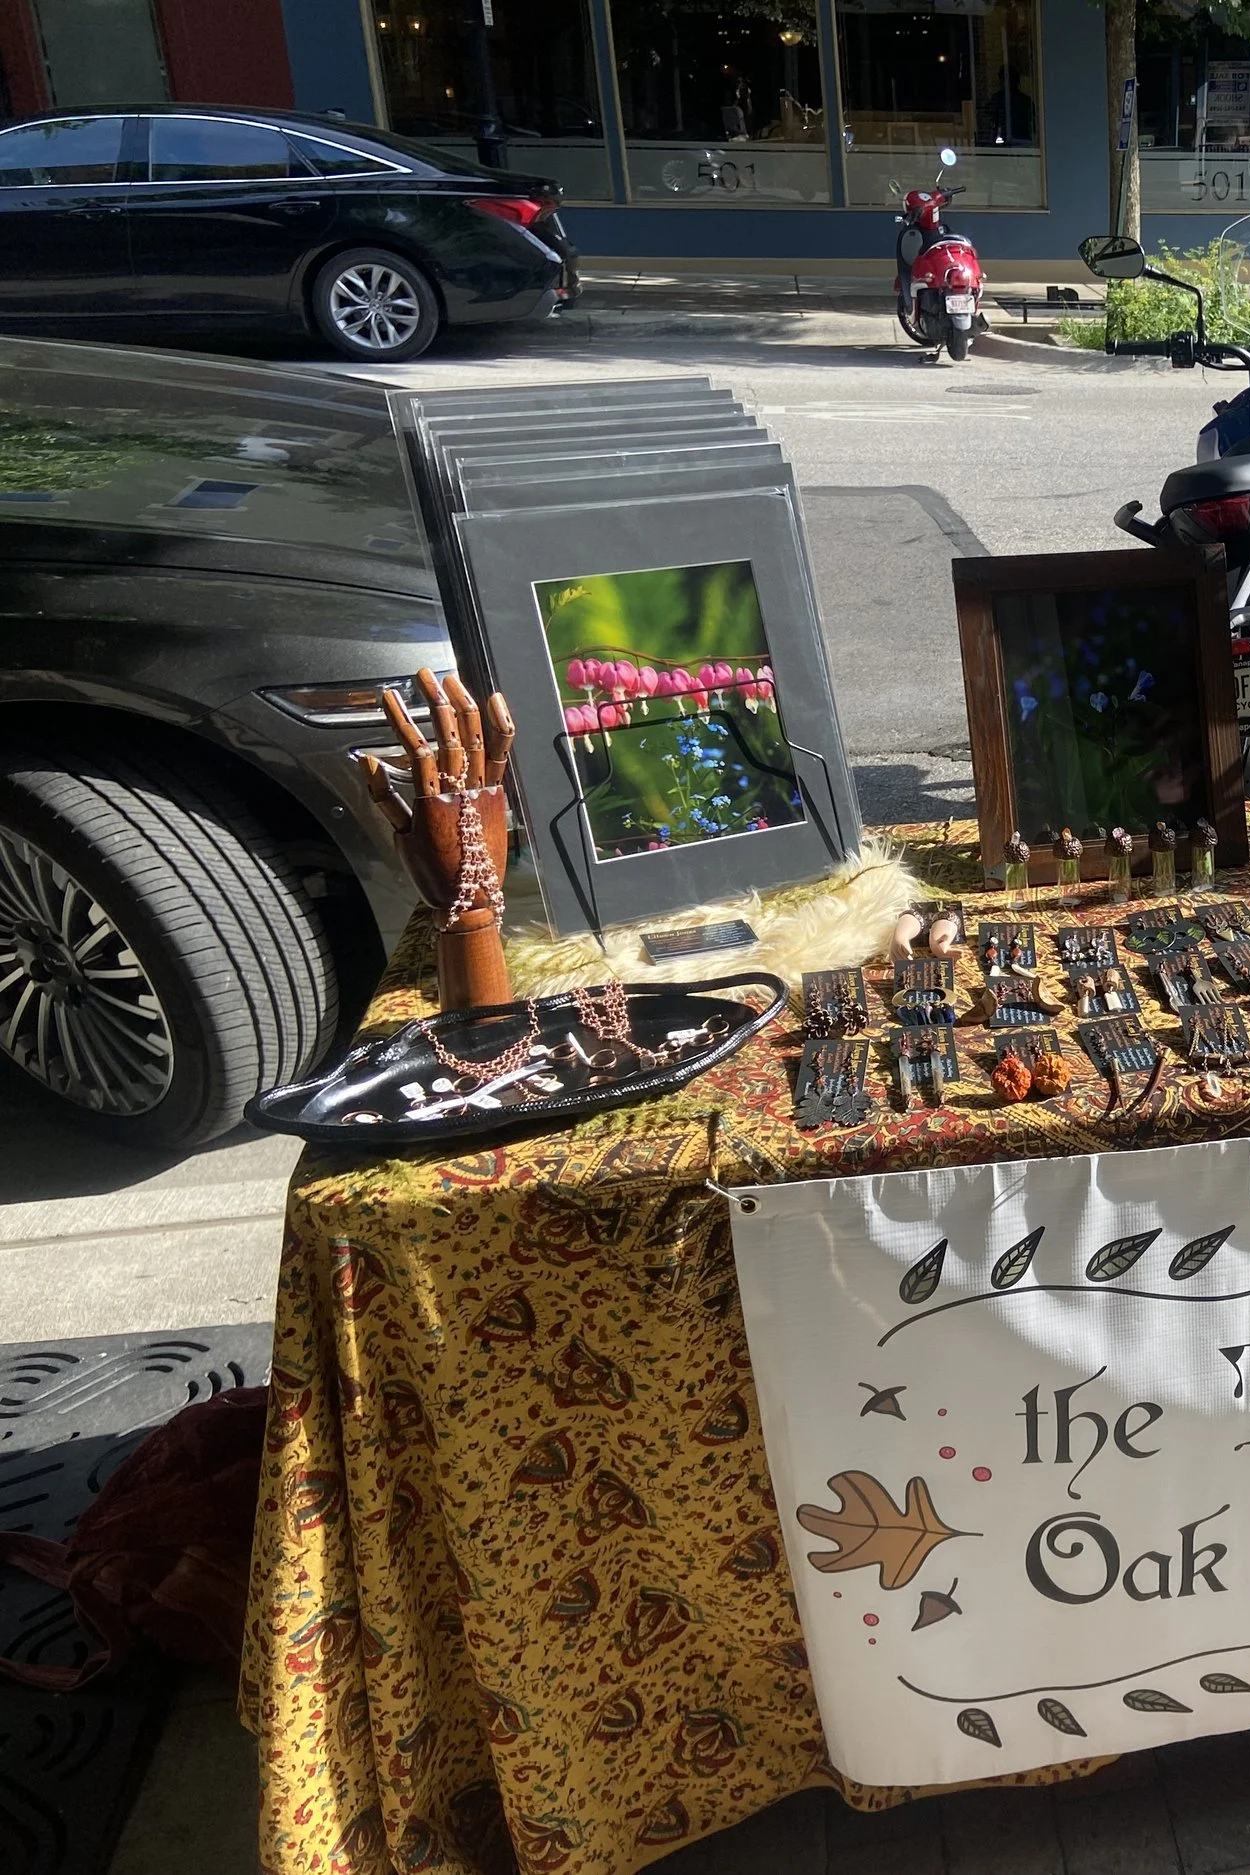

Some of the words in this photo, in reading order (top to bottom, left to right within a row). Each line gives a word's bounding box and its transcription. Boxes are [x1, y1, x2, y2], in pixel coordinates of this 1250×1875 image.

[1191, 171, 1248, 201] 501
[1015, 1366, 1164, 1500] the
[1025, 1503, 1230, 1606] Oak
